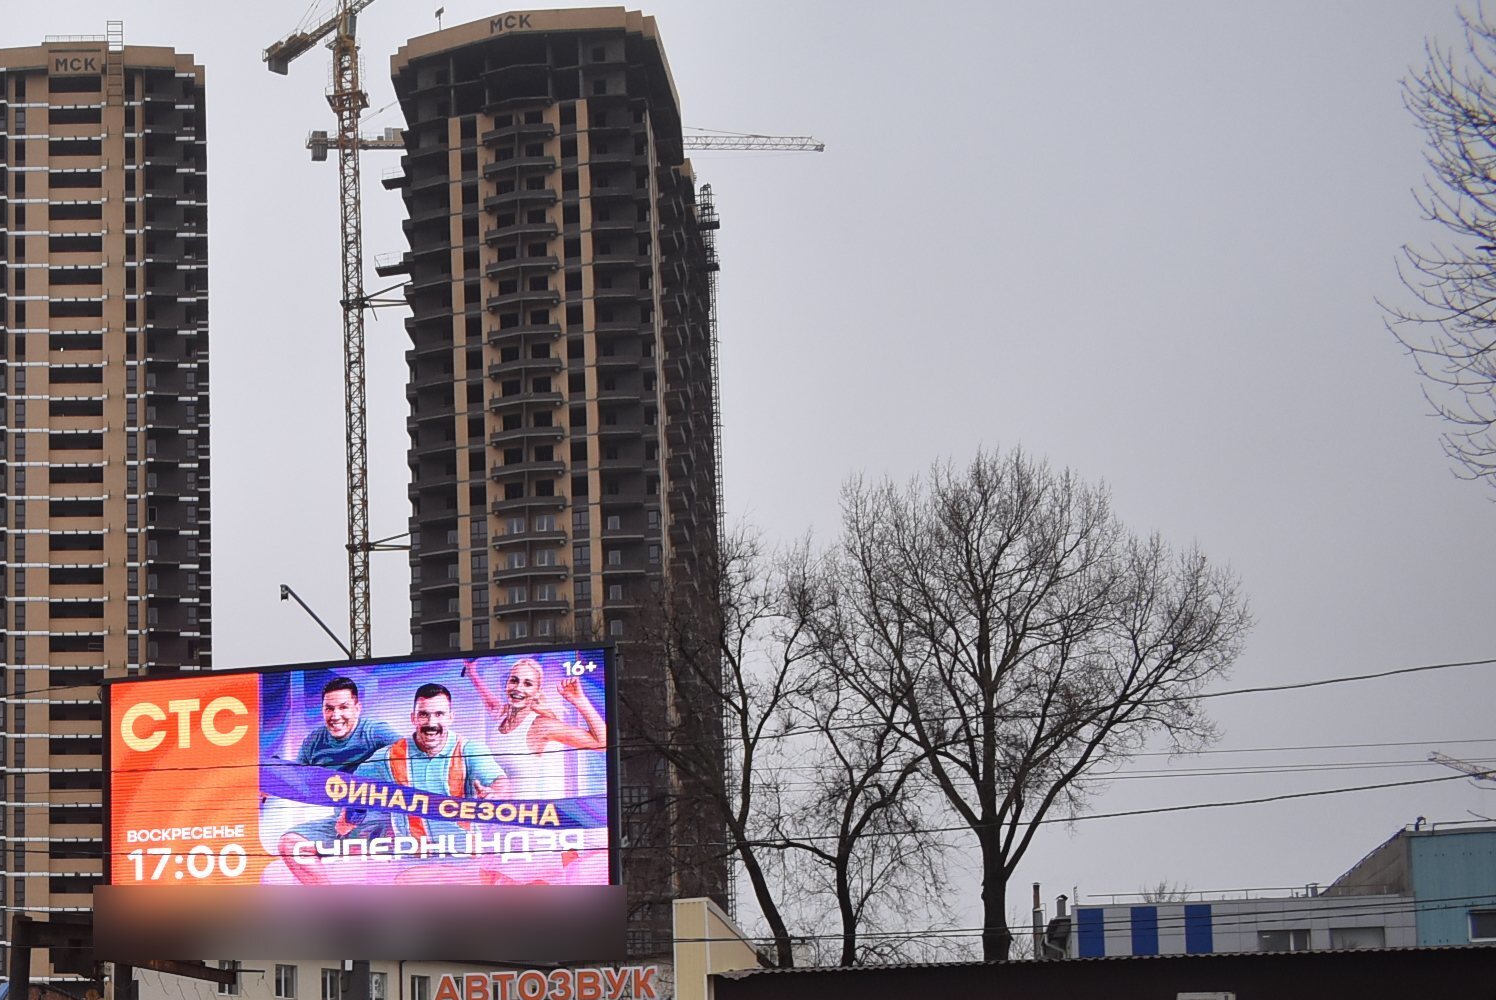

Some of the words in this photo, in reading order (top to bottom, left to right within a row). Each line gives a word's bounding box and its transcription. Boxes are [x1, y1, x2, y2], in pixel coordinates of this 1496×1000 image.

[489, 14, 532, 34] МСК
[55, 57, 96, 71] МСК
[562, 661, 597, 676] 16+
[121, 696, 248, 752] СТС
[325, 775, 429, 814] ФИНАЛ
[439, 799, 560, 826] СЕЗОНА
[126, 824, 245, 843] ВОСКРЕСЕНЬЕ
[292, 829, 584, 864] СУПЕРНИНДЗЯ
[127, 843, 247, 880] 17:00
